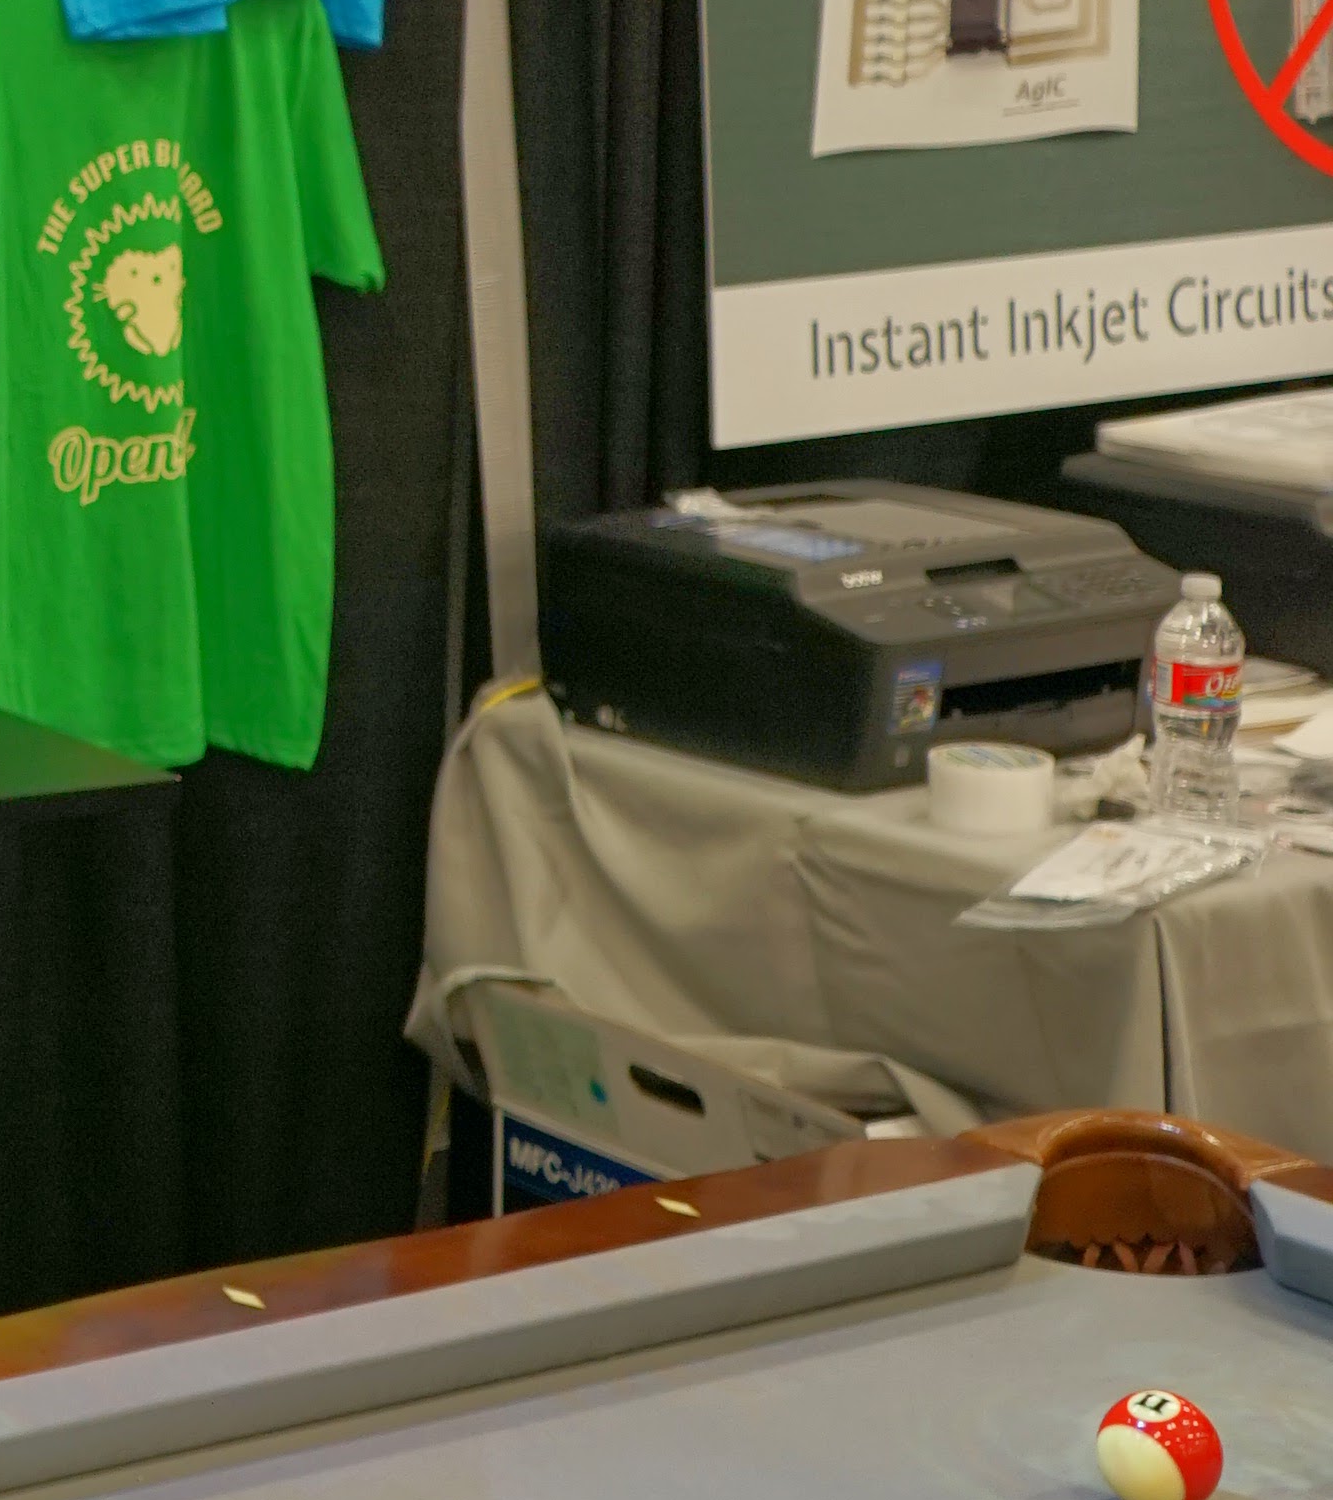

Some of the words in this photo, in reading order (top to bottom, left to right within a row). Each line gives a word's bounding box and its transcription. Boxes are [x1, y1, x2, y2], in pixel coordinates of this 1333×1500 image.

[37, 197, 76, 256] THE
[69, 139, 151, 204] SUPER
[810, 306, 989, 379] Instant
[1007, 289, 1150, 365] Inkjet
